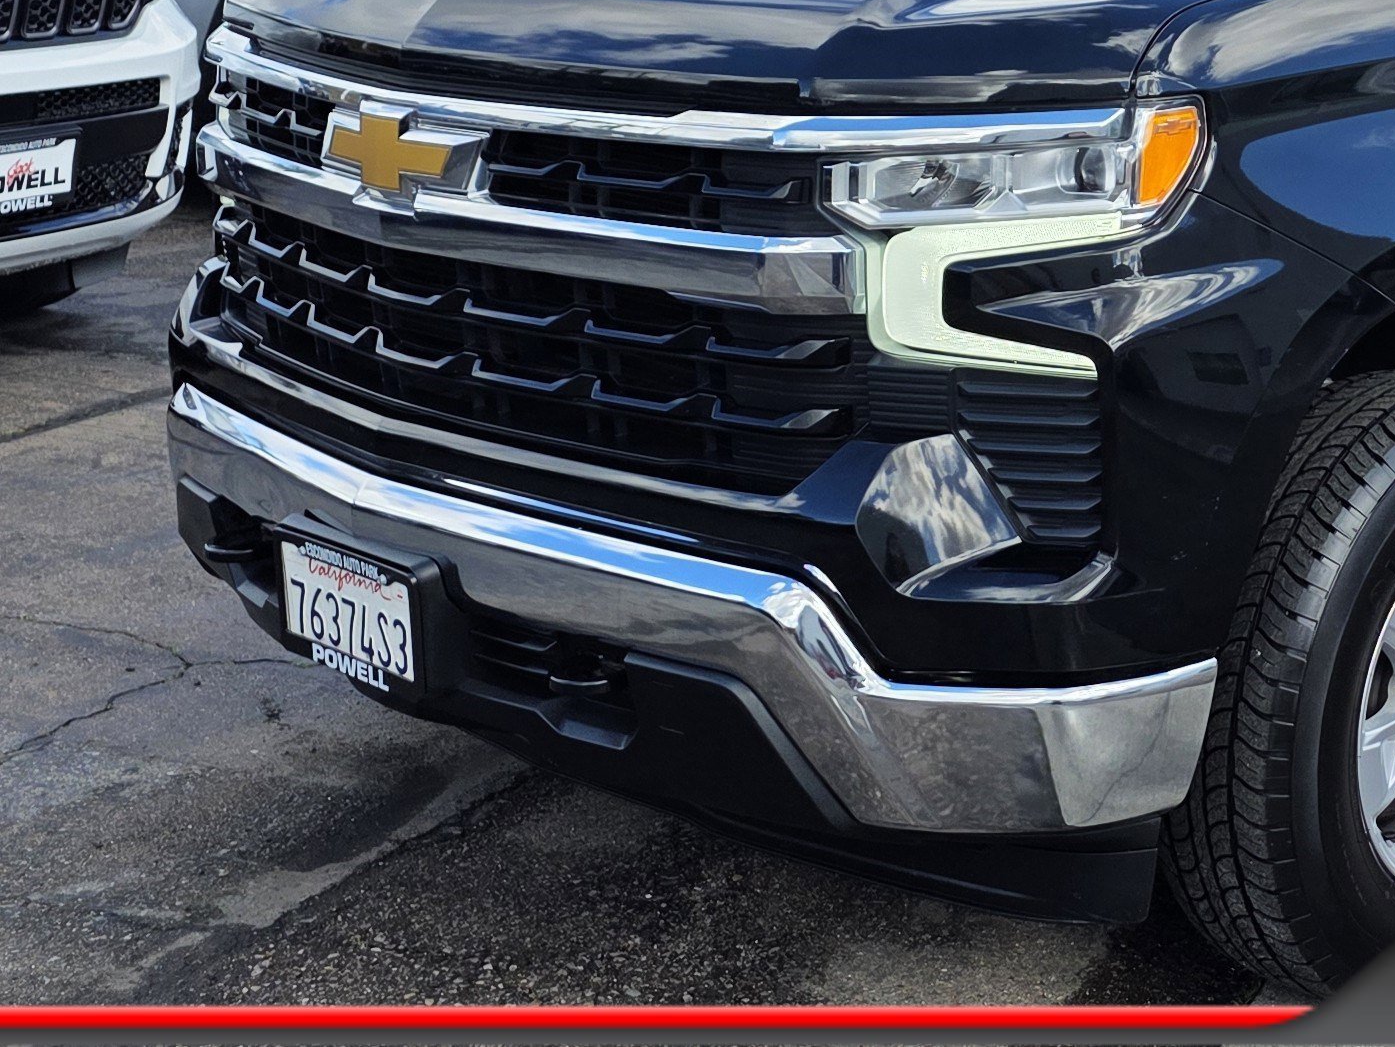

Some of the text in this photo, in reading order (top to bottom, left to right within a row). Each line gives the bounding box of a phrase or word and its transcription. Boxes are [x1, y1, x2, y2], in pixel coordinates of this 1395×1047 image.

[308, 556, 391, 601] California
[290, 577, 408, 675] 76374S3
[312, 643, 389, 692] POWELL
